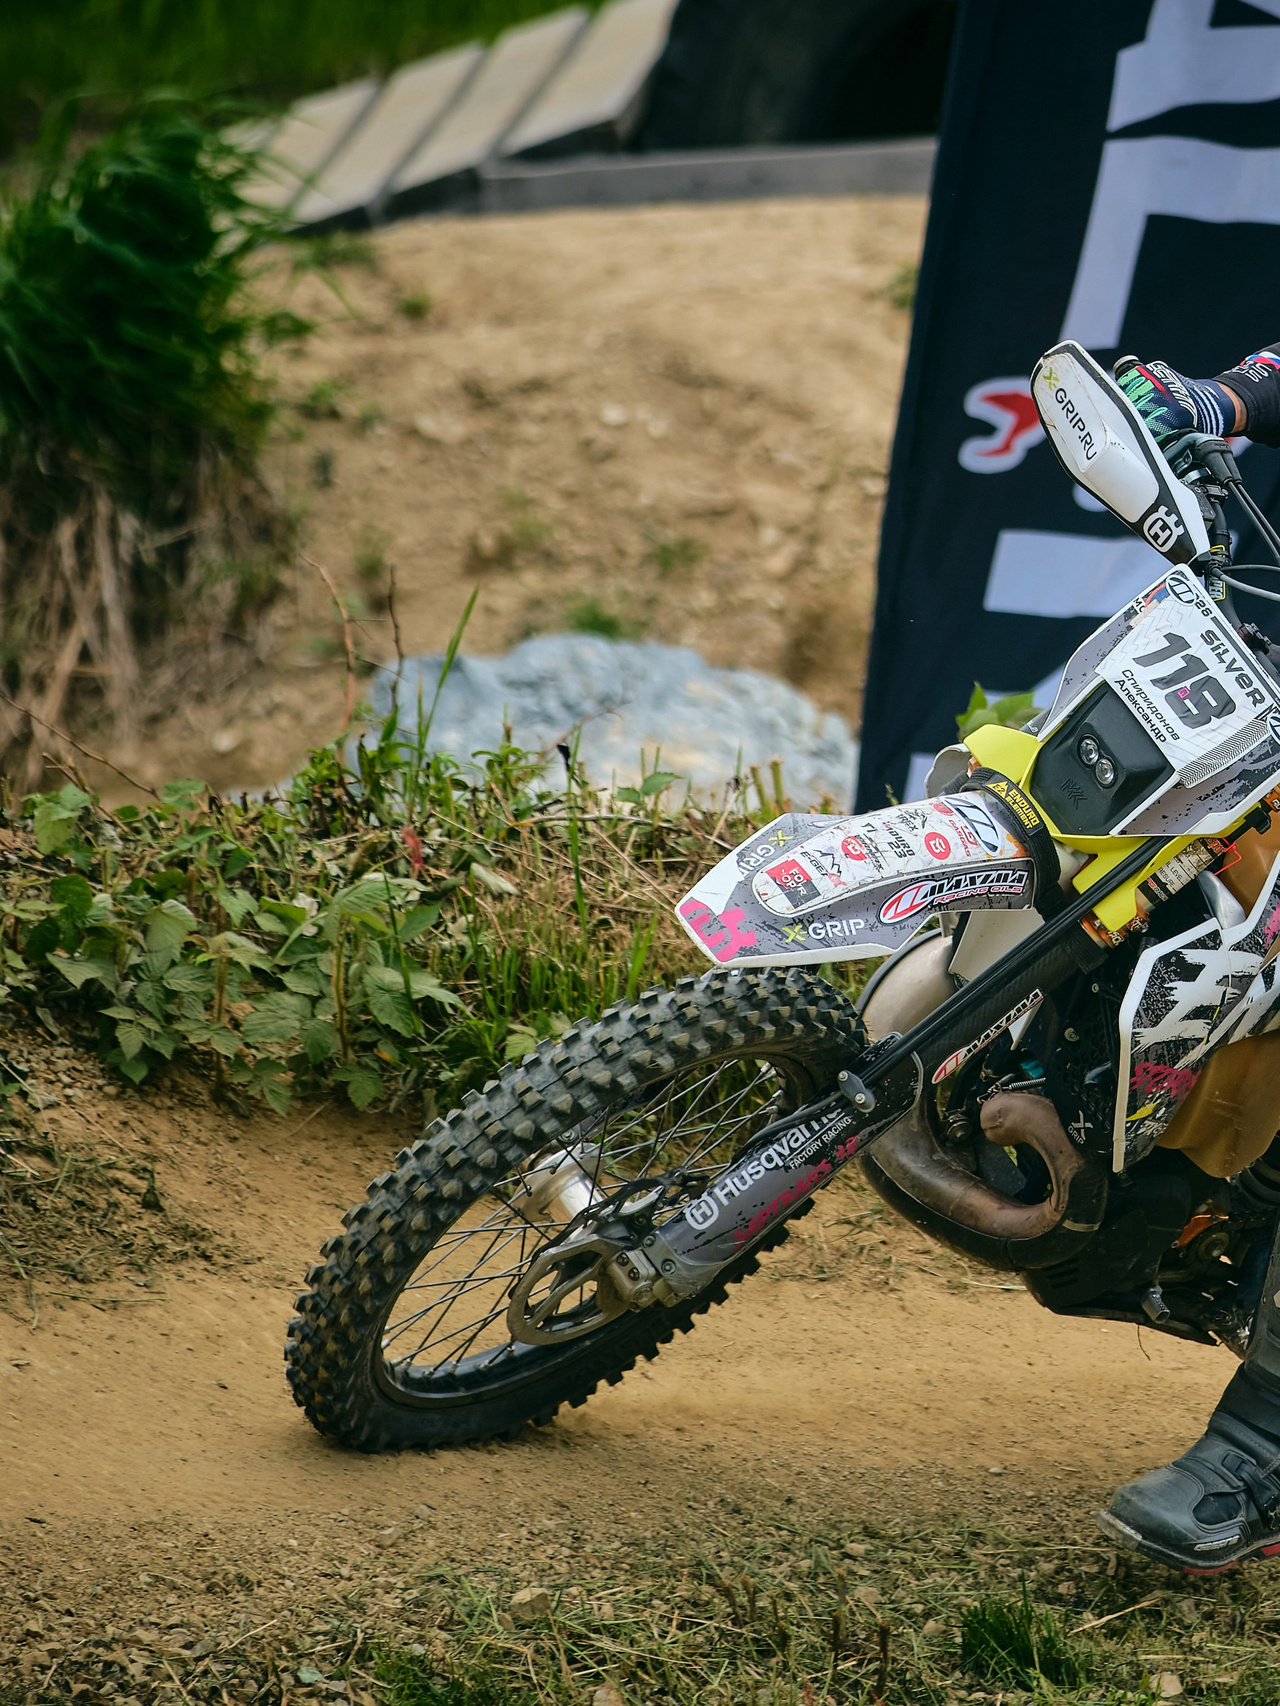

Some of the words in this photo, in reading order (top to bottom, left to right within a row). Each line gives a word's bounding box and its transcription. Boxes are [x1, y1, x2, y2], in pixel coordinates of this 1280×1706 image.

[1114, 678, 1168, 744] Александр
[1121, 669, 1181, 741] Спиридонов
[1005, 796, 1033, 830] ELEMENT
[1008, 788, 1040, 827] ENDURO
[933, 887, 989, 905] RACING
[990, 885, 1024, 894] OILS
[782, 918, 865, 944] X-GRIP
[789, 1139, 823, 1170] FACTORY
[822, 1117, 852, 1144] RACING
[1067, 1126, 1084, 1145] GRIP
